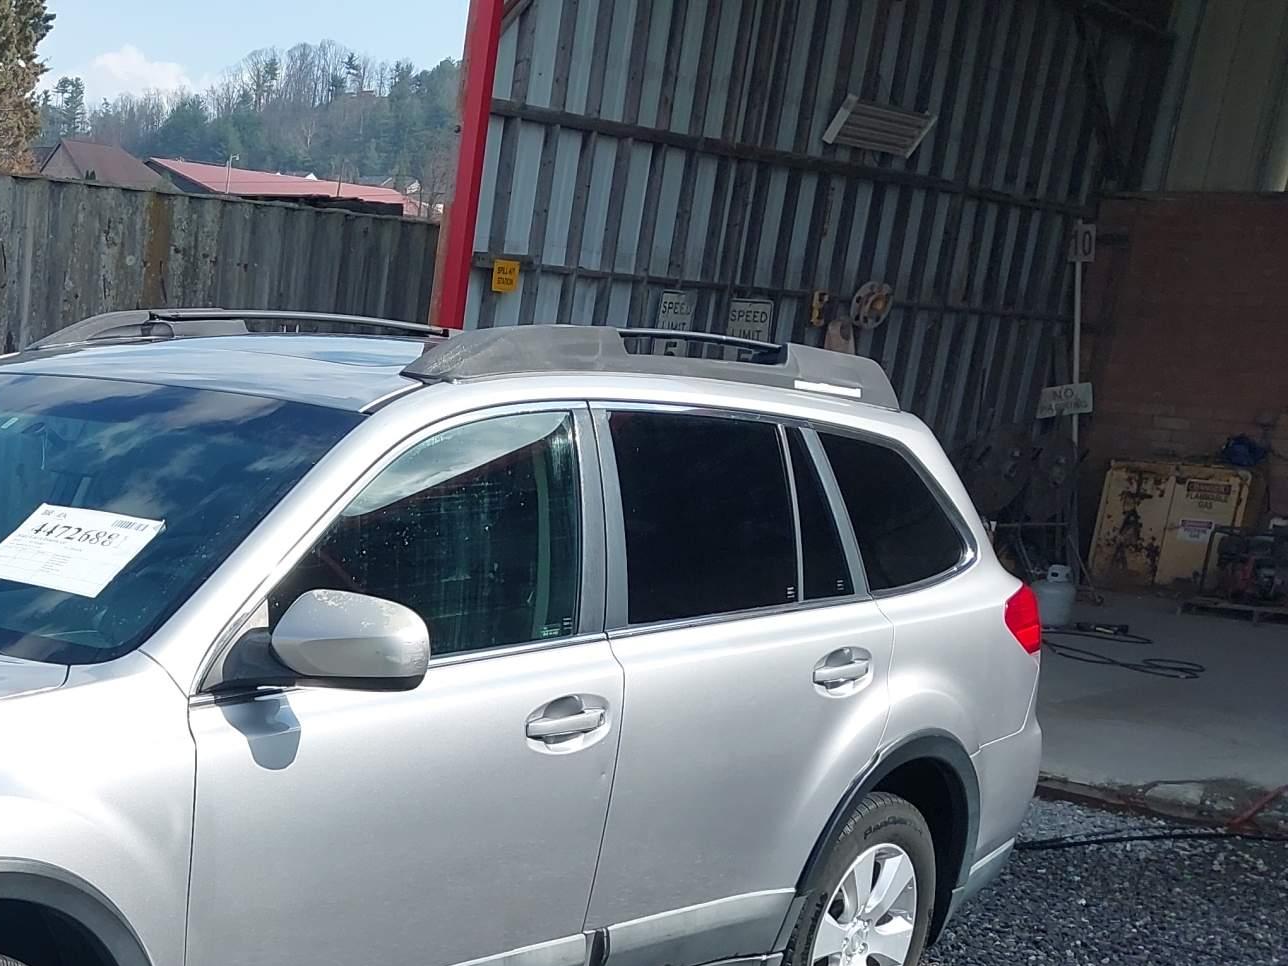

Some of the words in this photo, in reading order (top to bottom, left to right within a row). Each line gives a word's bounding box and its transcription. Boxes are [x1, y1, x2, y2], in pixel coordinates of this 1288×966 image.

[661, 301, 691, 316] SPEED
[730, 309, 768, 324] SPEED
[1053, 387, 1074, 402] NO
